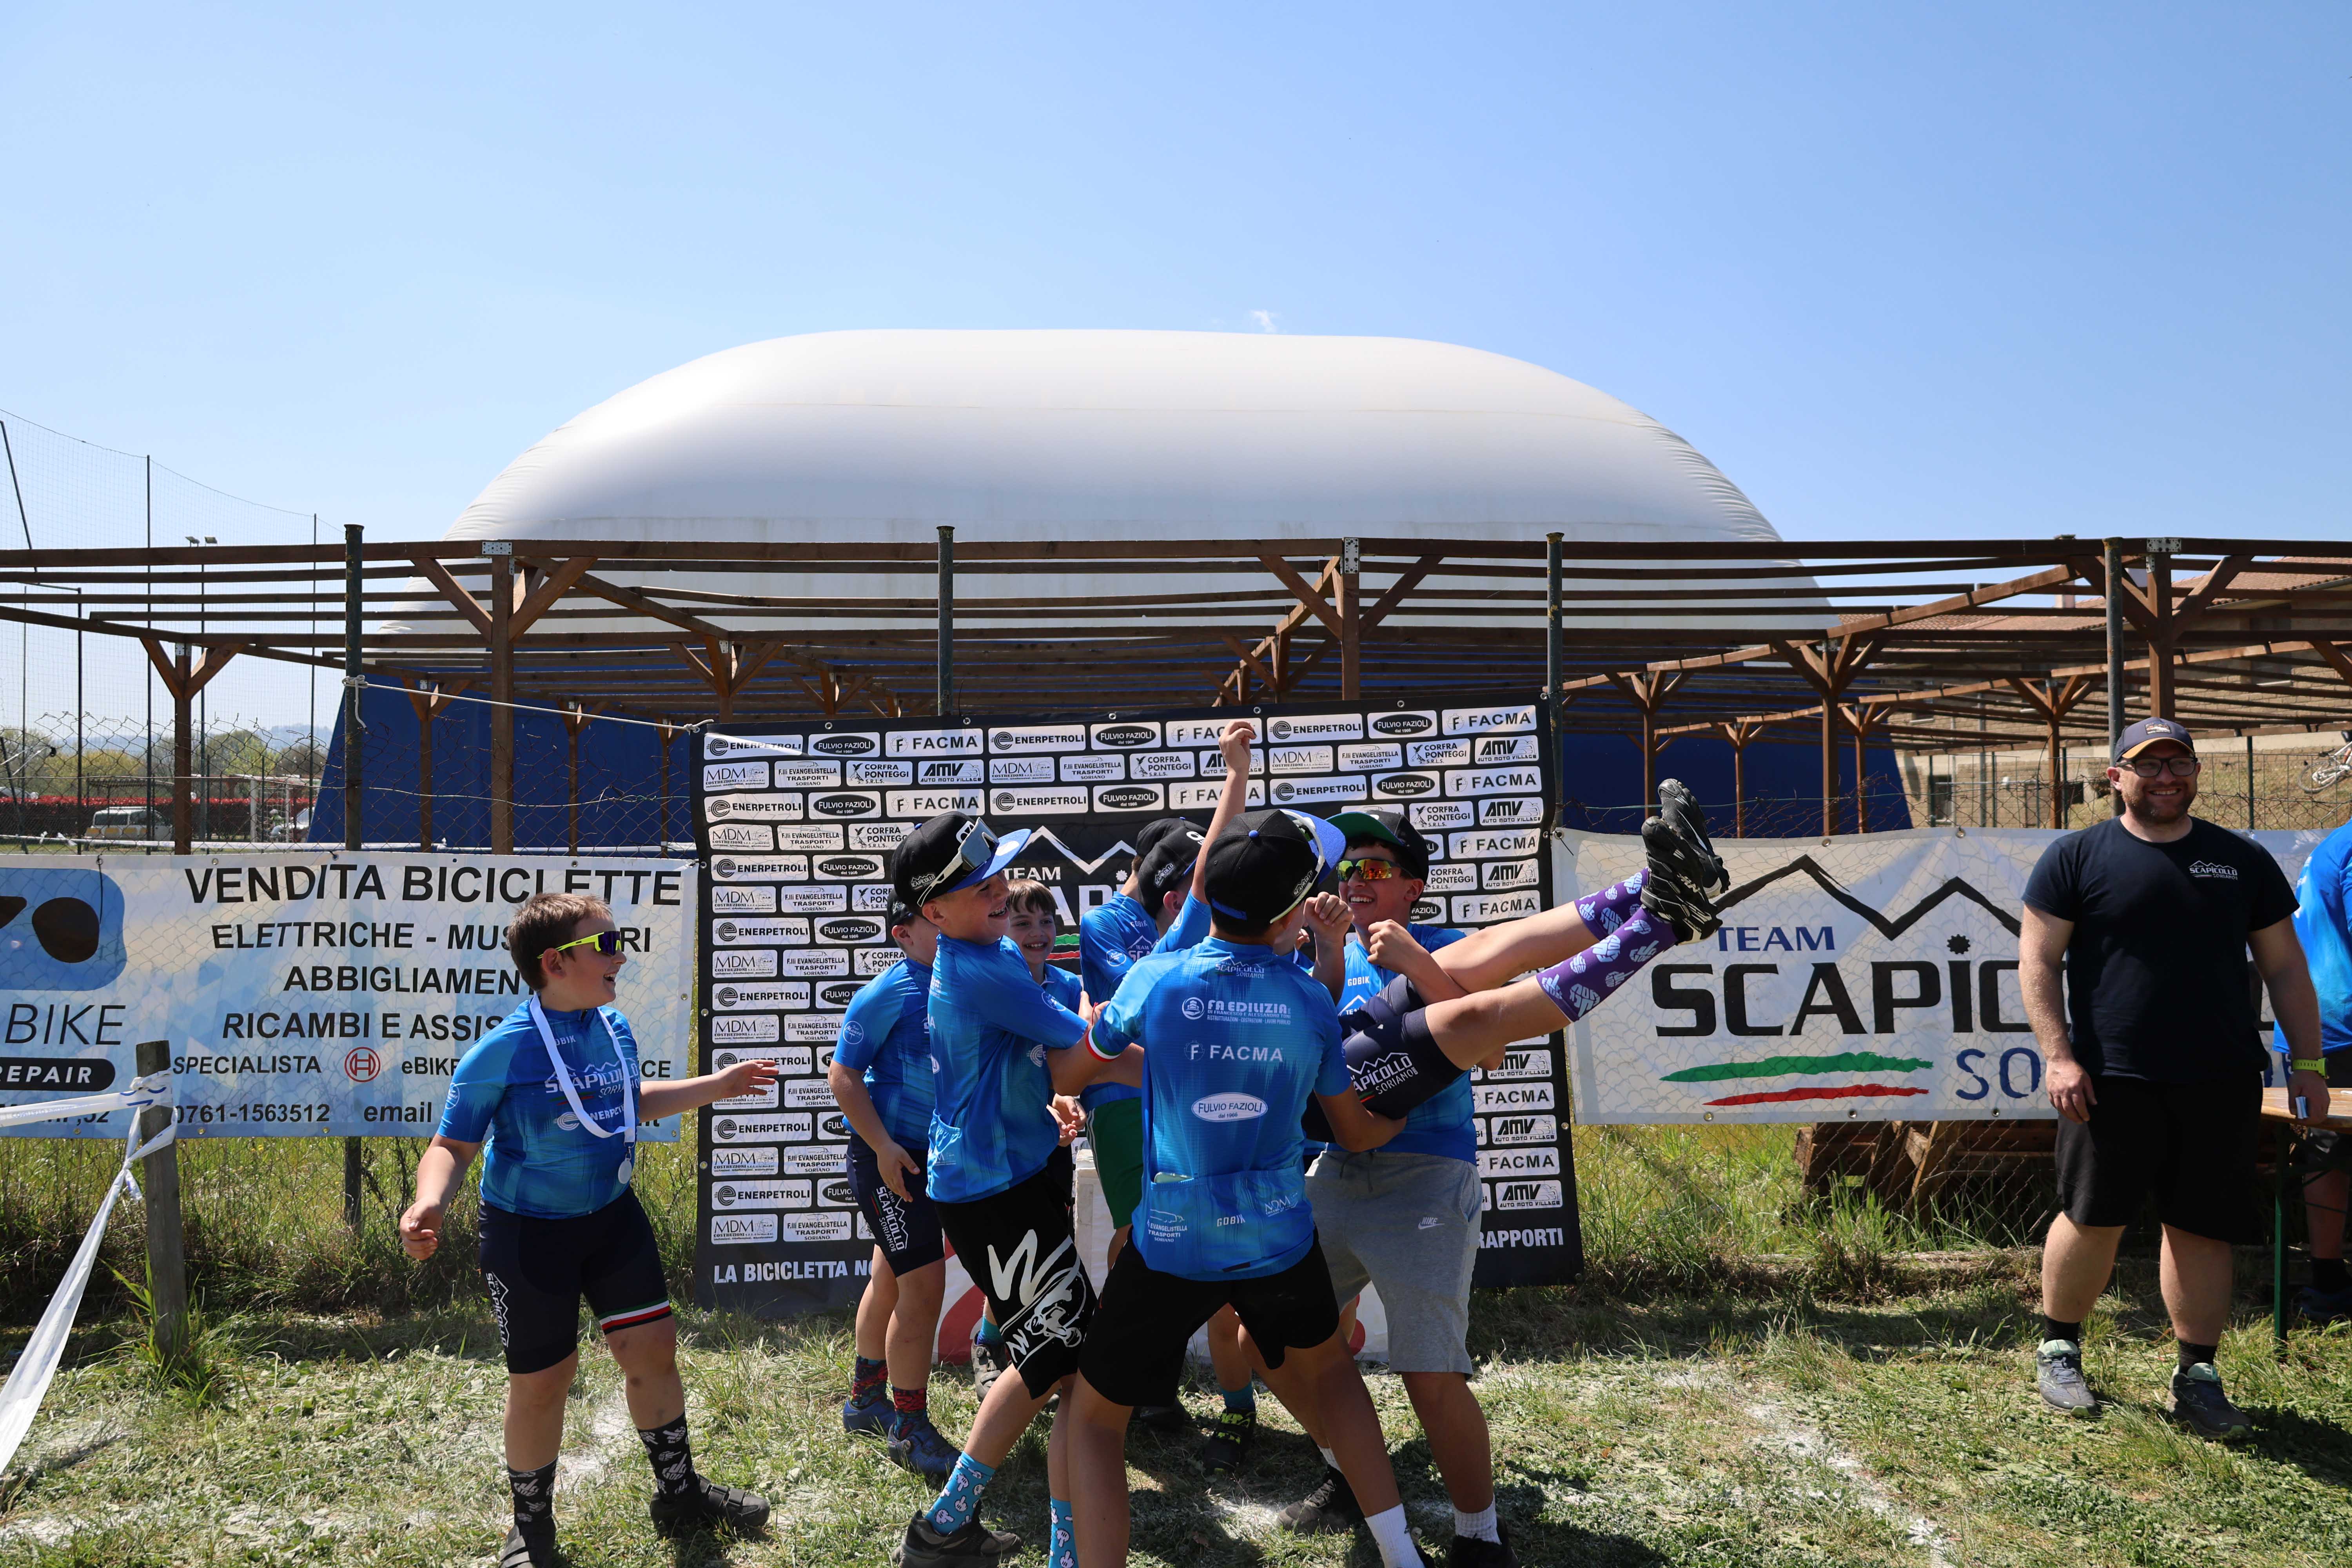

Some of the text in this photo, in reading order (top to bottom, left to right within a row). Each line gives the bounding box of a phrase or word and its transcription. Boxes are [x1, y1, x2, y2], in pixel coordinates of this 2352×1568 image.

[1403, 719, 1428, 728] FAZIOLI
[1468, 711, 1531, 727] FACMA
[1126, 731, 1152, 739] FAZIOLI
[1294, 723, 1361, 734] ENERPETROLI
[845, 741, 871, 749] FAZIOLI
[913, 735, 978, 750] FACMA
[1015, 734, 1084, 744] ENERPETROLI
[1424, 742, 1457, 751] CORFRA
[1480, 739, 1518, 756] AMV
[1272, 751, 1311, 763] MDM
[1425, 750, 1466, 759] PONTEGGI
[706, 767, 746, 781] MDM
[924, 762, 964, 776] AMV
[993, 762, 1032, 775] MDM
[1406, 779, 1431, 788] FAZIOLI
[1472, 773, 1537, 789] FACMA
[1296, 784, 1365, 795] ENERPETROLI
[914, 796, 979, 810] FACMA
[1017, 796, 1086, 806] ENERPETROLI
[1129, 793, 1155, 801] FAZIOLI
[733, 802, 802, 811] ENERPETROLI
[1485, 800, 1523, 817] AMV
[1427, 813, 1470, 822] PONTEGGI
[1476, 836, 1535, 851] FACMA
[737, 864, 806, 873] ENERPETROLI
[1488, 864, 1524, 881] AMV
[185, 864, 386, 903] VENDITA
[1431, 875, 1473, 884] PONTEGGI
[1479, 898, 1536, 915] FACMA
[212, 922, 414, 949] ELETTRICHE
[739, 927, 808, 936] ENERPETROLI
[1717, 926, 1834, 952] TEAM
[1348, 976, 1370, 987] GOBIK
[740, 991, 809, 1001] ENERPETROLI
[1228, 1001, 1287, 1014] EDILIZIA
[5, 1003, 126, 1045] BIKE
[223, 1012, 370, 1039] RICAMBI
[382, 1013, 401, 1038] E
[1210, 1045, 1284, 1062] FACMA
[172, 1054, 322, 1074] SPECIALISTA
[0, 1065, 92, 1083] EPAIR
[1485, 1089, 1549, 1105] FACMA
[363, 1102, 432, 1123] email
[1198, 1102, 1263, 1114] FULVIO FAZIOLI
[739, 1123, 810, 1133] ENERPETROLI
[1497, 1118, 1536, 1136] AMV
[1490, 1154, 1555, 1170] FACMA
[738, 1190, 810, 1200] ENERPETROLI
[1502, 1184, 1541, 1201] AMV
[715, 1220, 754, 1233] MDM
[1150, 1223, 1188, 1232] EVANGELISTELLA
[1421, 1217, 1439, 1225] NIKE
[714, 1259, 848, 1283] LA BICICLETTA
